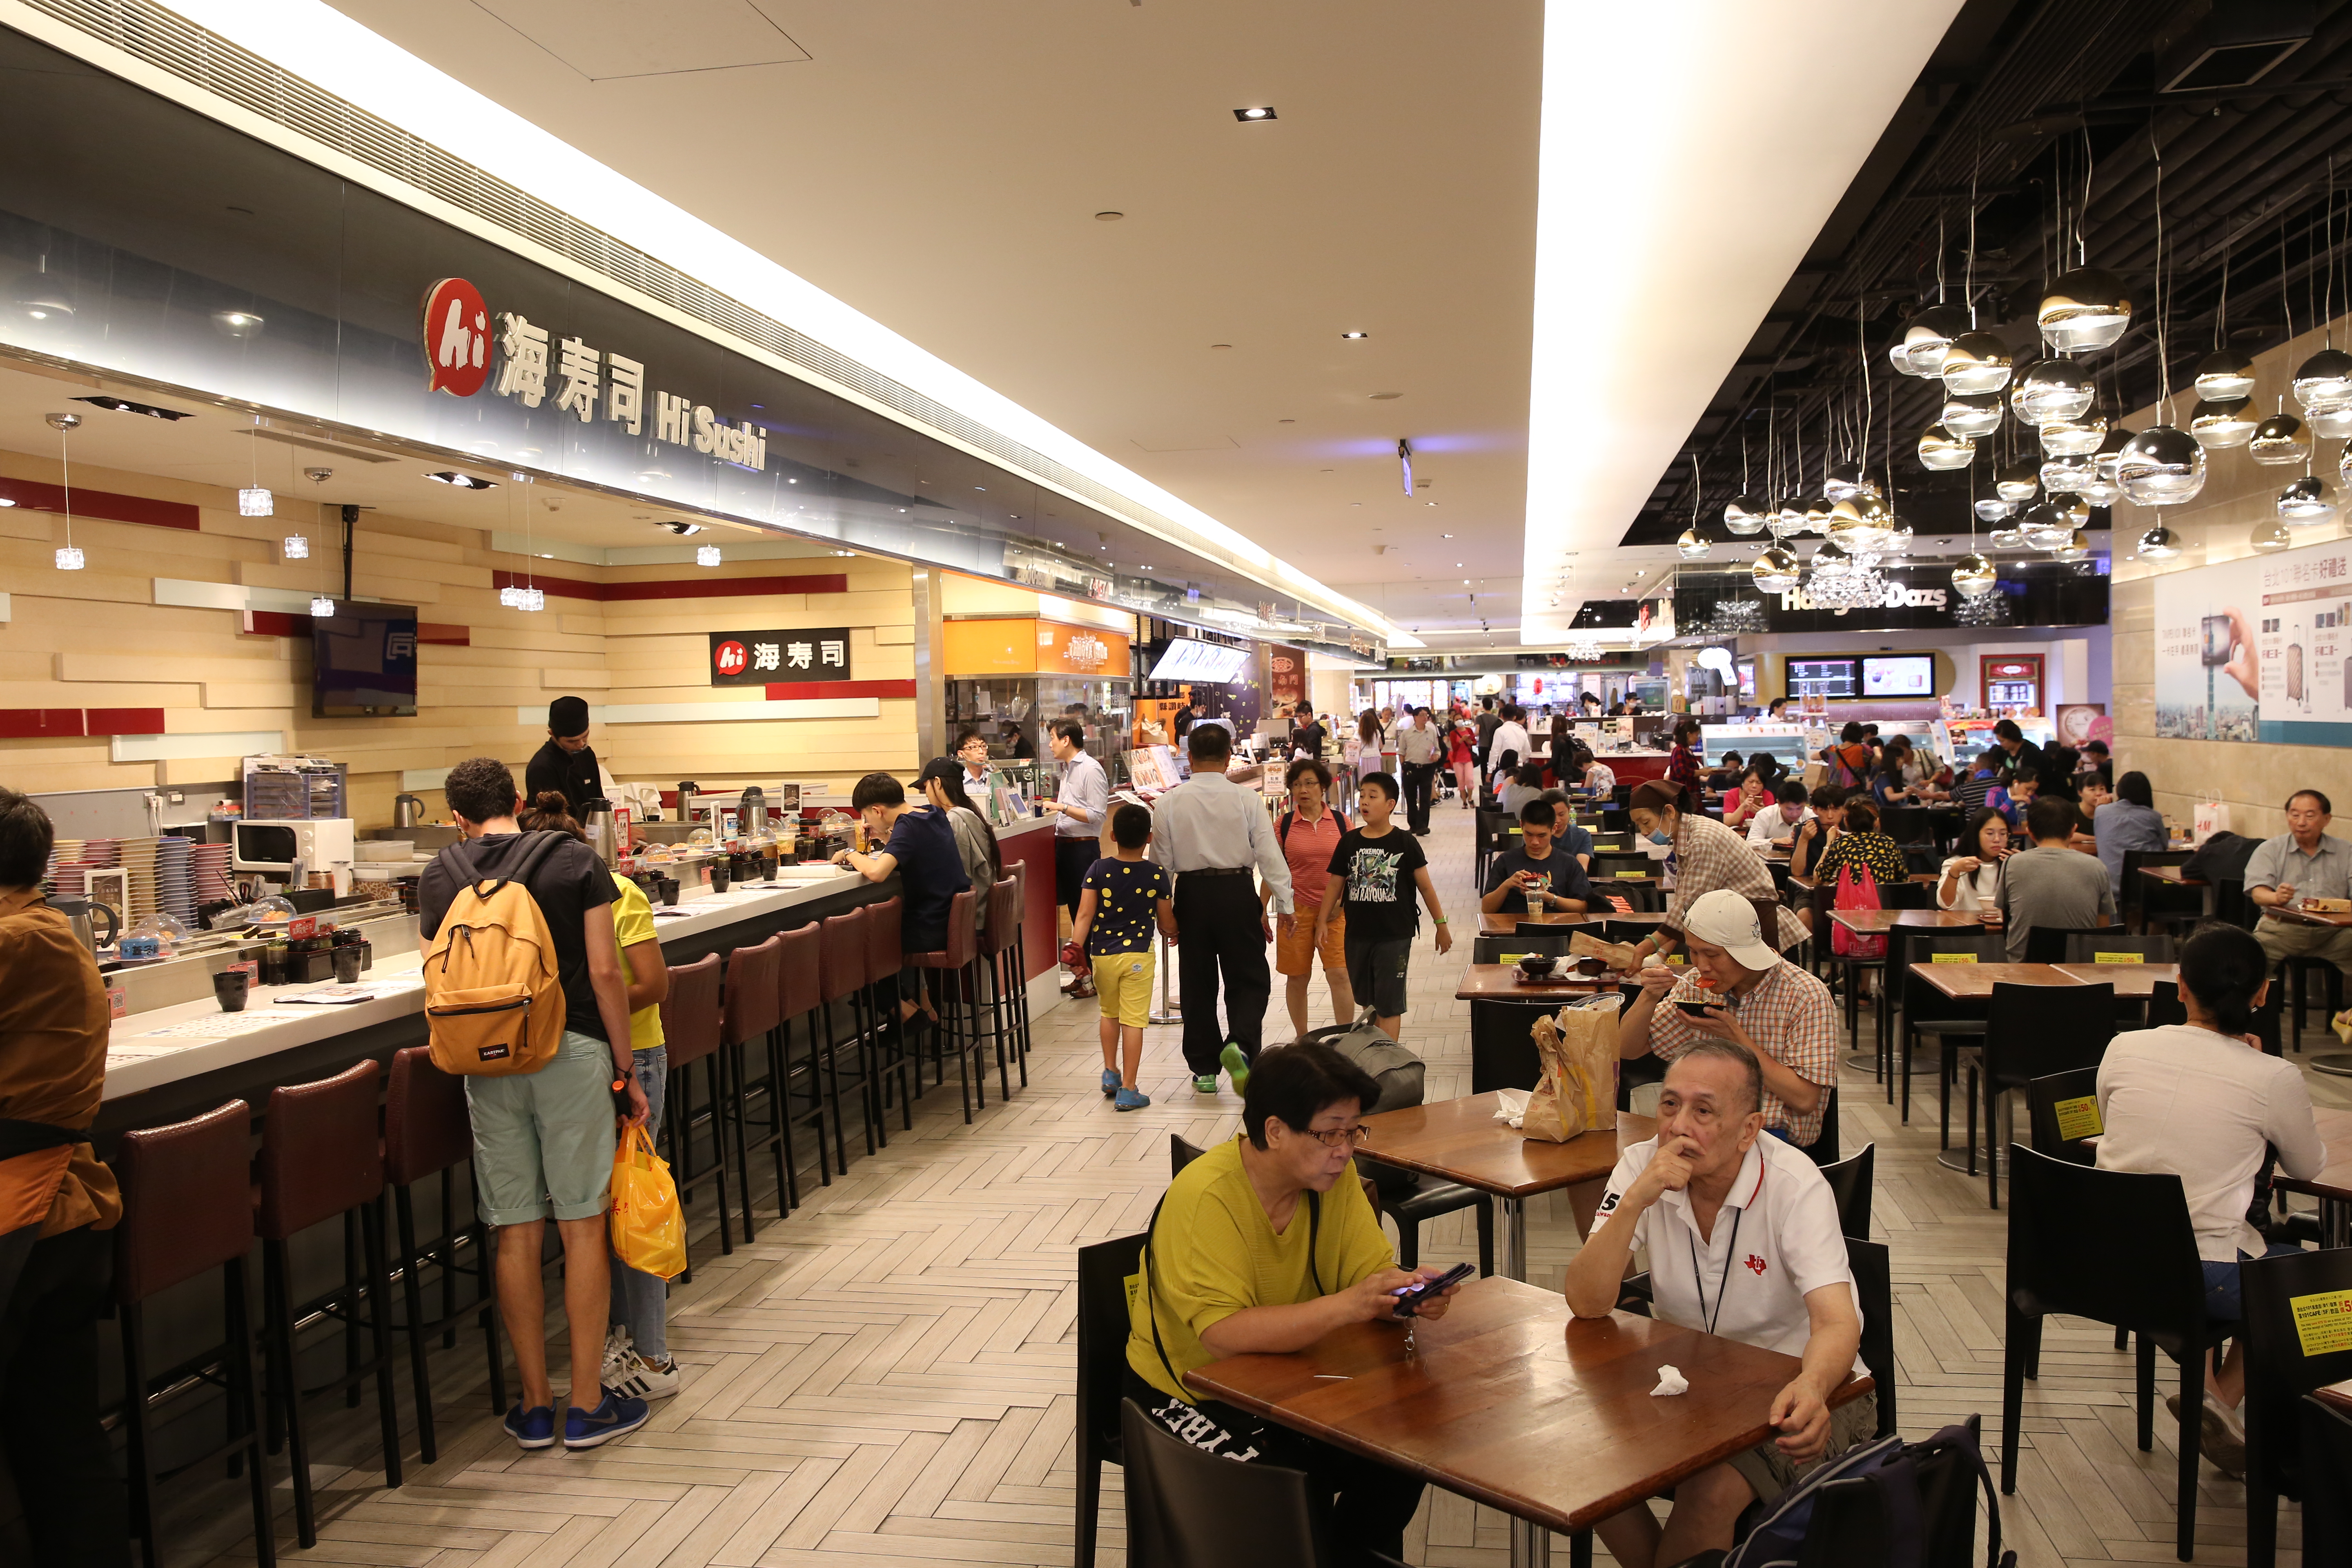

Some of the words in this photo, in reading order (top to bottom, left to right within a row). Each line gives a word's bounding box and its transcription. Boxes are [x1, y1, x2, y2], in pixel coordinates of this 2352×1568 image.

[495, 312, 644, 436] 海寿司
[655, 391, 690, 445] Hi
[694, 405, 766, 470] Sushi
[753, 640, 844, 670] 海寿司
[2080, 1103, 2089, 1112] 50
[2344, 1300, 2352, 1312] 5
